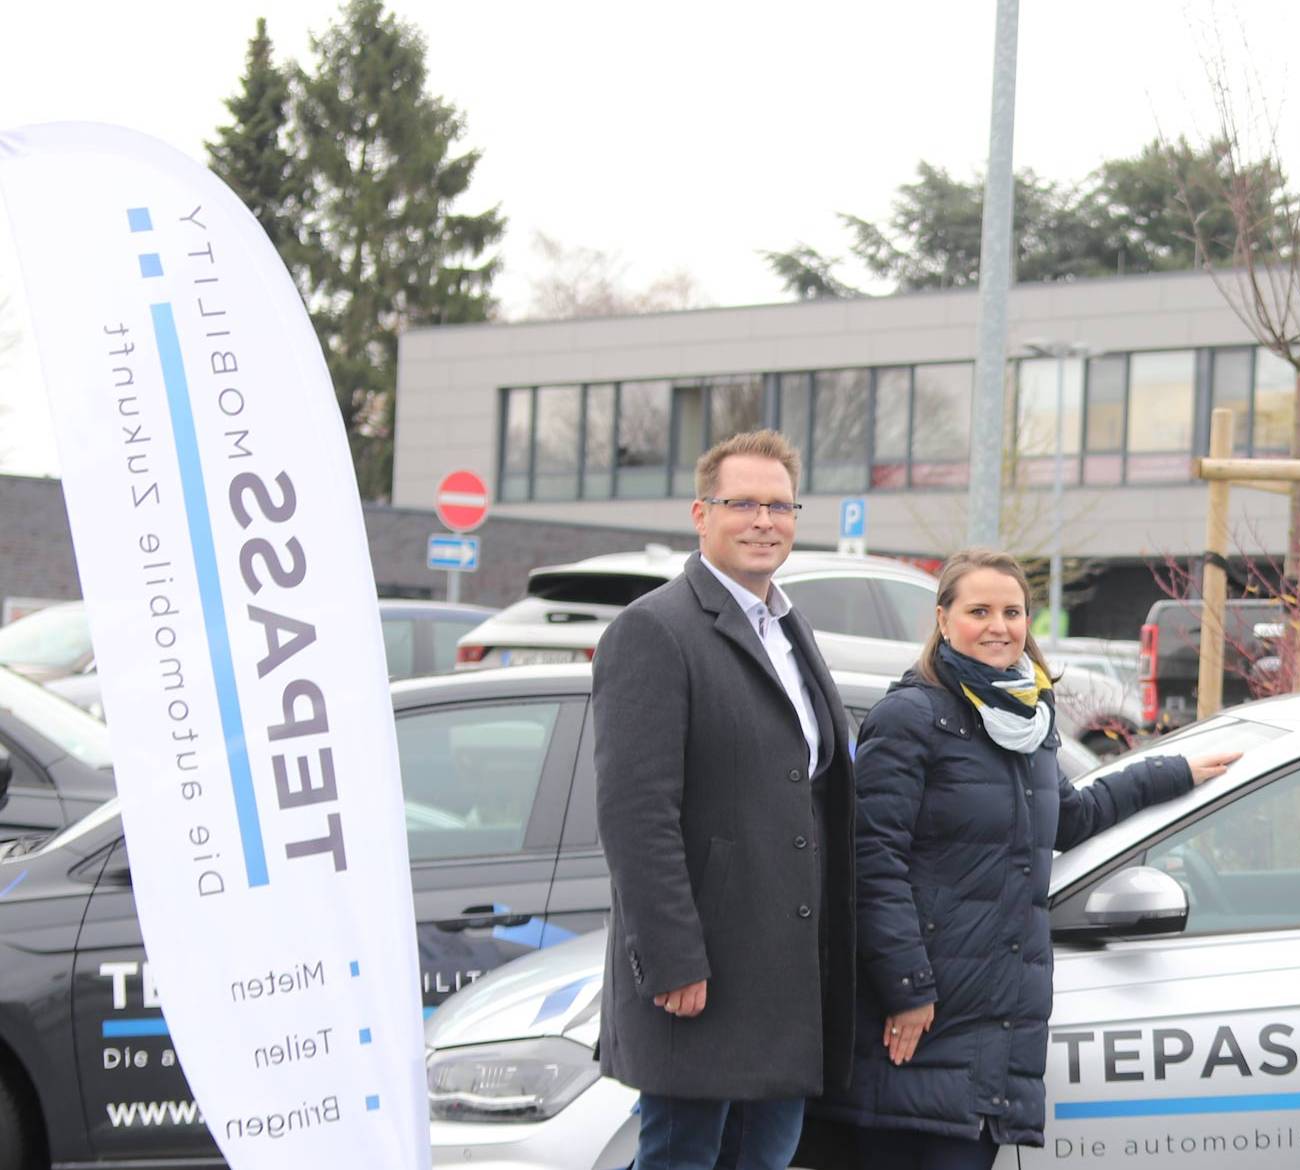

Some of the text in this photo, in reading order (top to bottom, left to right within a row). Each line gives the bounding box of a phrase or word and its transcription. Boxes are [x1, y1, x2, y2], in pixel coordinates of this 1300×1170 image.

[845, 503, 861, 533] P
[103, 1047, 148, 1070] Die
[1055, 1136, 1106, 1159] Die
